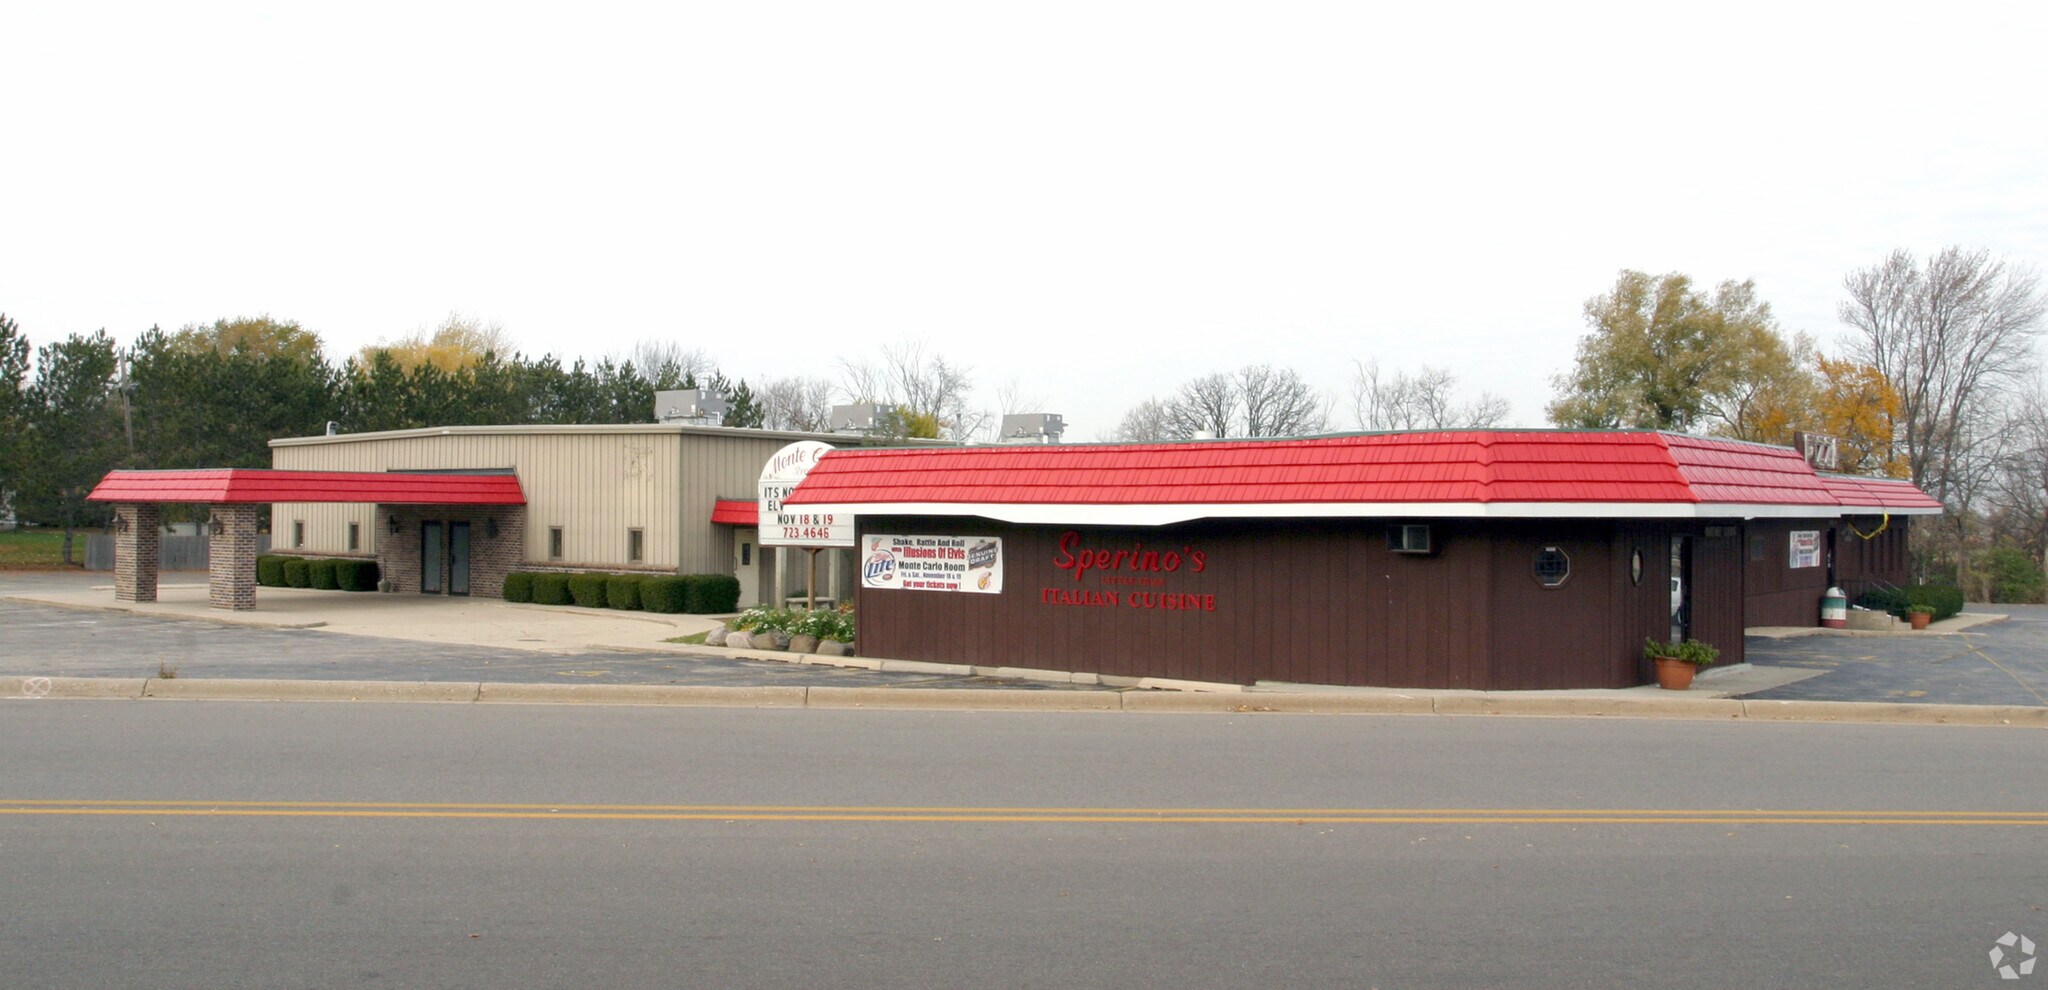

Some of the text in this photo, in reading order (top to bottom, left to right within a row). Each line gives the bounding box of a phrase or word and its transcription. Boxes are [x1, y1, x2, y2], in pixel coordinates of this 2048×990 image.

[764, 487, 779, 498] ITS
[777, 513, 833, 525] NOV 18 & 19
[783, 527, 829, 539] 723 4646
[903, 547, 937, 558] Illusions
[938, 548, 946, 559] Of
[947, 548, 965, 559] Elvis
[1053, 530, 1206, 581] Sperino's
[898, 561, 965, 571] Monte Carlo Room
[1042, 588, 1217, 612] ITALIAN CUISINE
